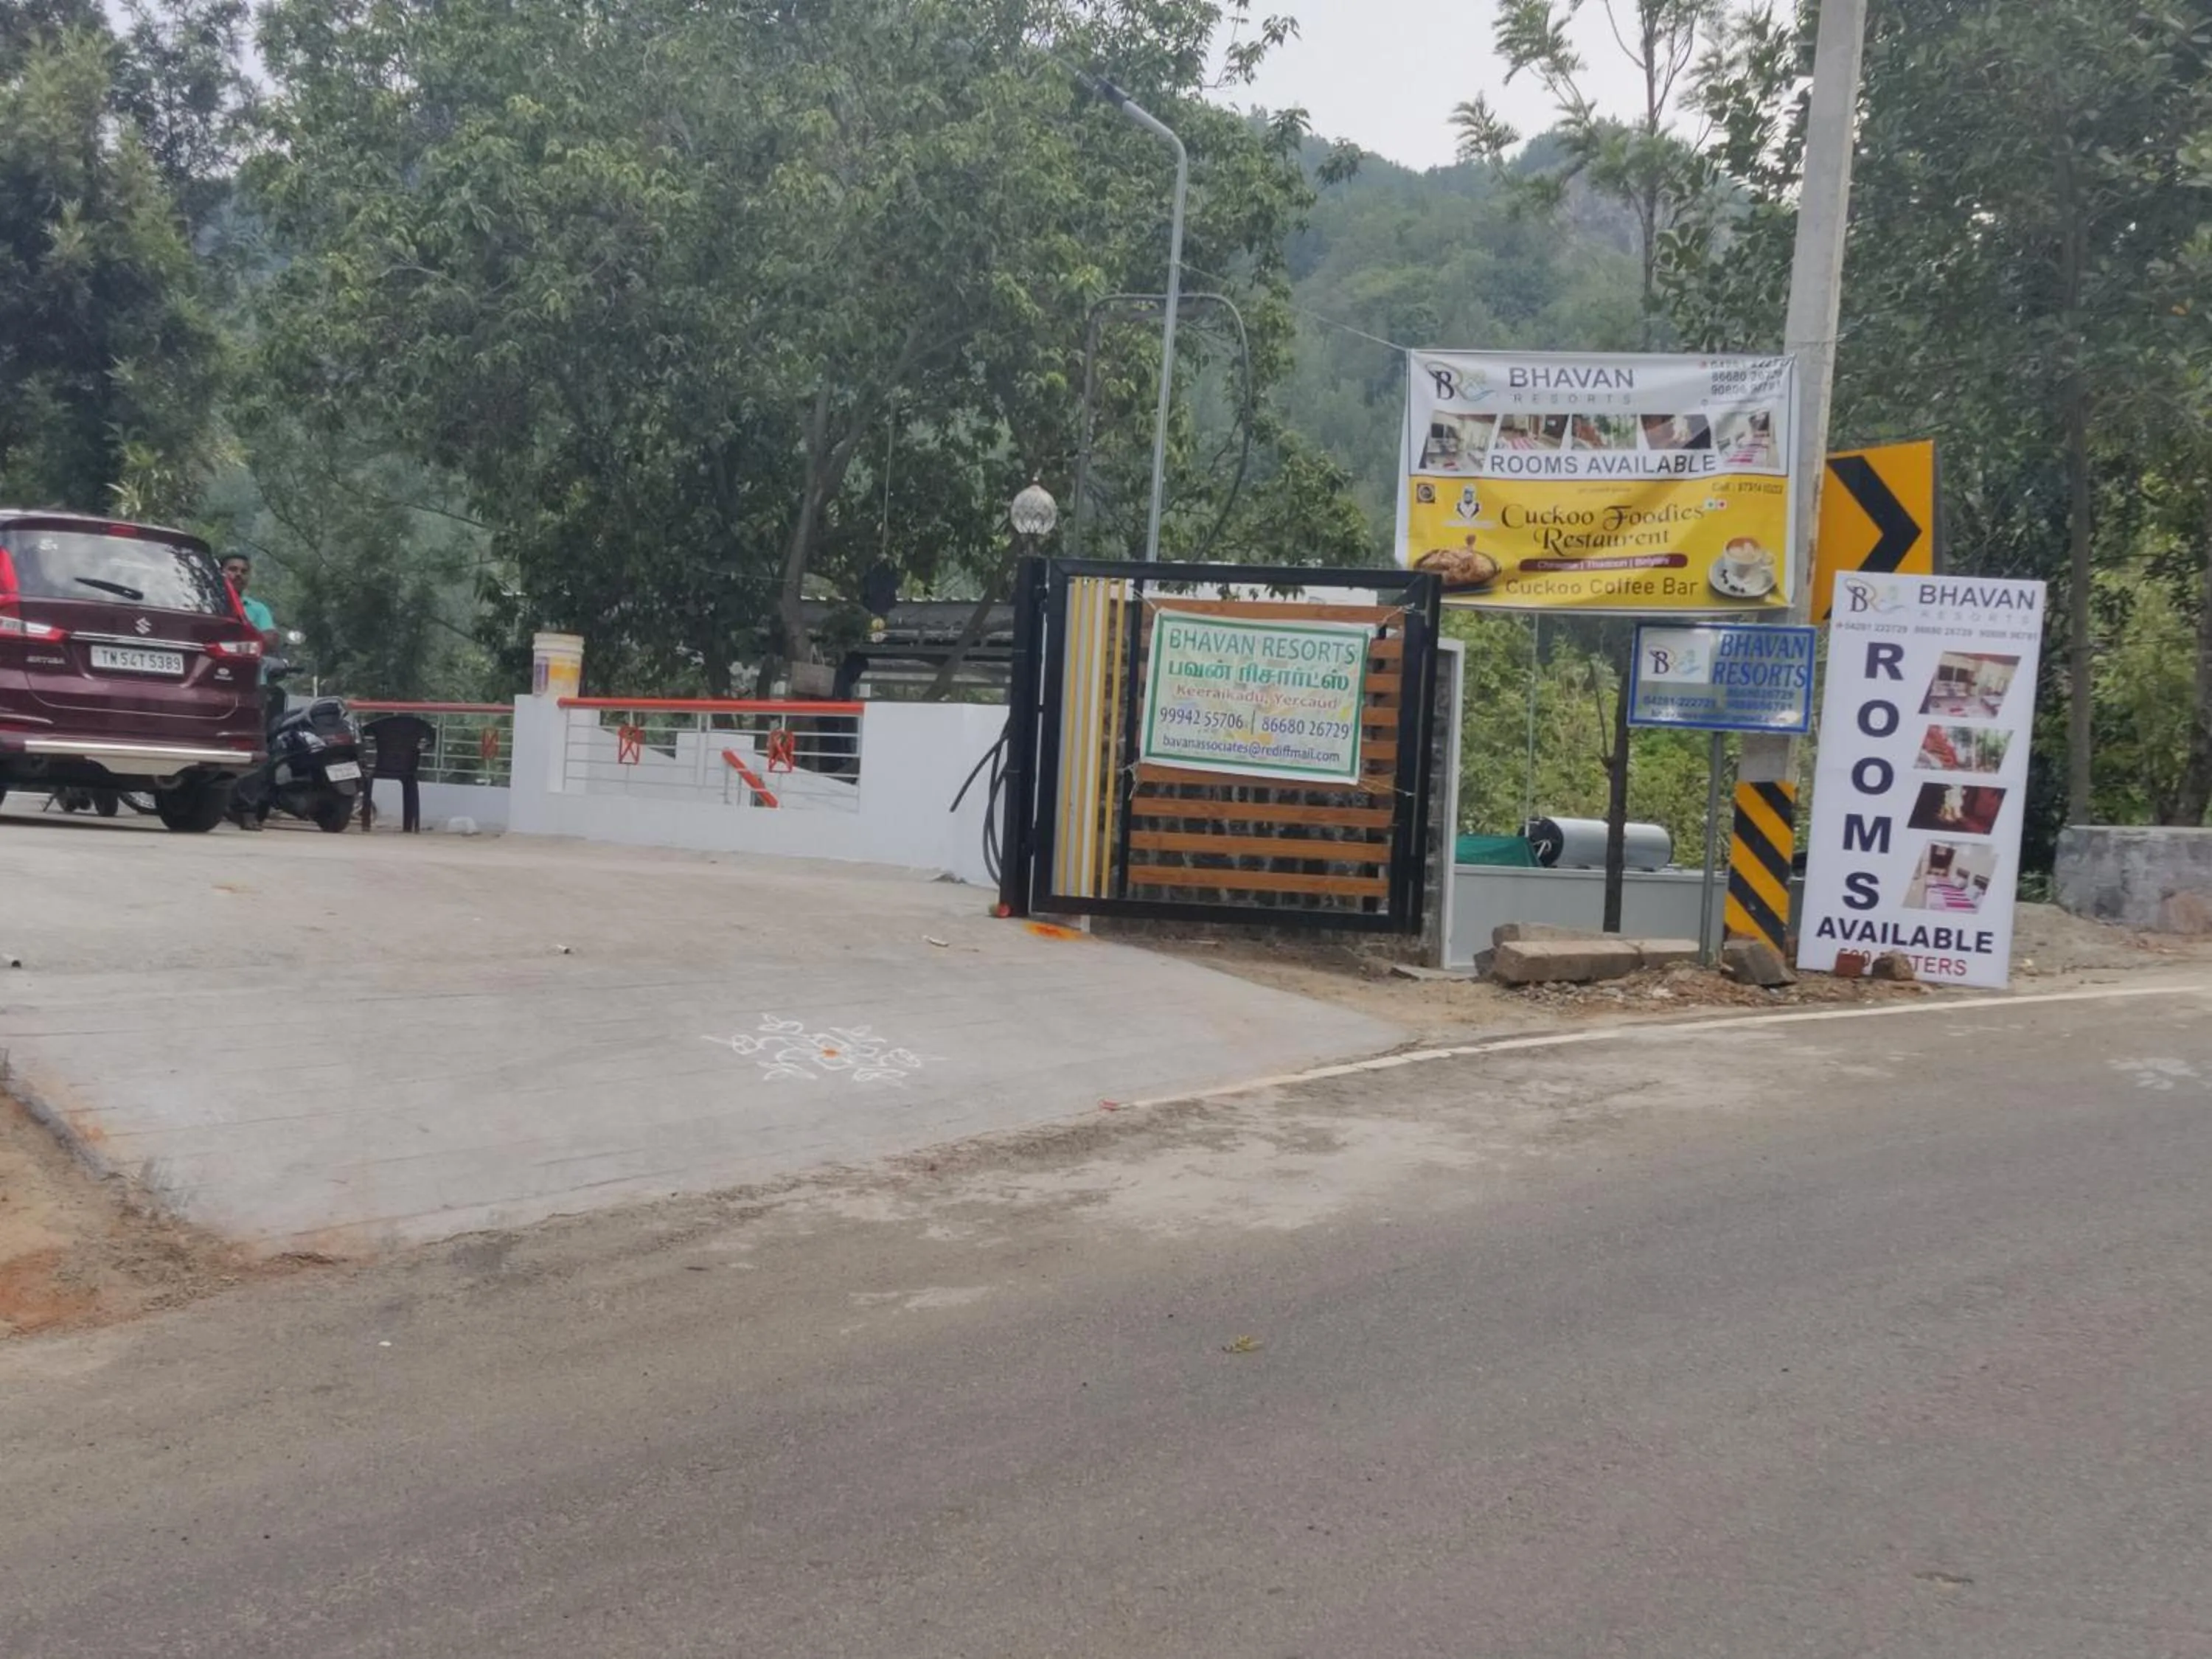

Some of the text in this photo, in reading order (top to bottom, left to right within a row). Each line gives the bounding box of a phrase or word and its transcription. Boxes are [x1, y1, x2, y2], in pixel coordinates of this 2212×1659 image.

[1509, 367, 1634, 389] BHAVAN
[1514, 394, 1632, 405] RESORTS
[1490, 454, 1717, 474] ROOMS AVAILABLE
[1500, 504, 1705, 532] Cuckoo Foodies
[1533, 526, 1670, 557] Restaurent
[1506, 577, 1699, 595] Cuckoo Coffee Bar
[1919, 584, 2036, 610] BHAVAN
[1921, 611, 2029, 625] RESORTS
[1169, 628, 1356, 664] BHAVAN RESORTS
[1720, 633, 1806, 658] BHAVAN
[1168, 659, 1232, 681] பவன்
[1711, 662, 1806, 688] RESORTS
[1274, 692, 1338, 709] Yercaud
[1159, 707, 1349, 740] 99942 55706 86680 26729
[1163, 735, 1340, 762] bavanassociates@rediffmail.com
[1842, 641, 1905, 911] ROOMS
[1816, 917, 1994, 954] AVAILABLE
